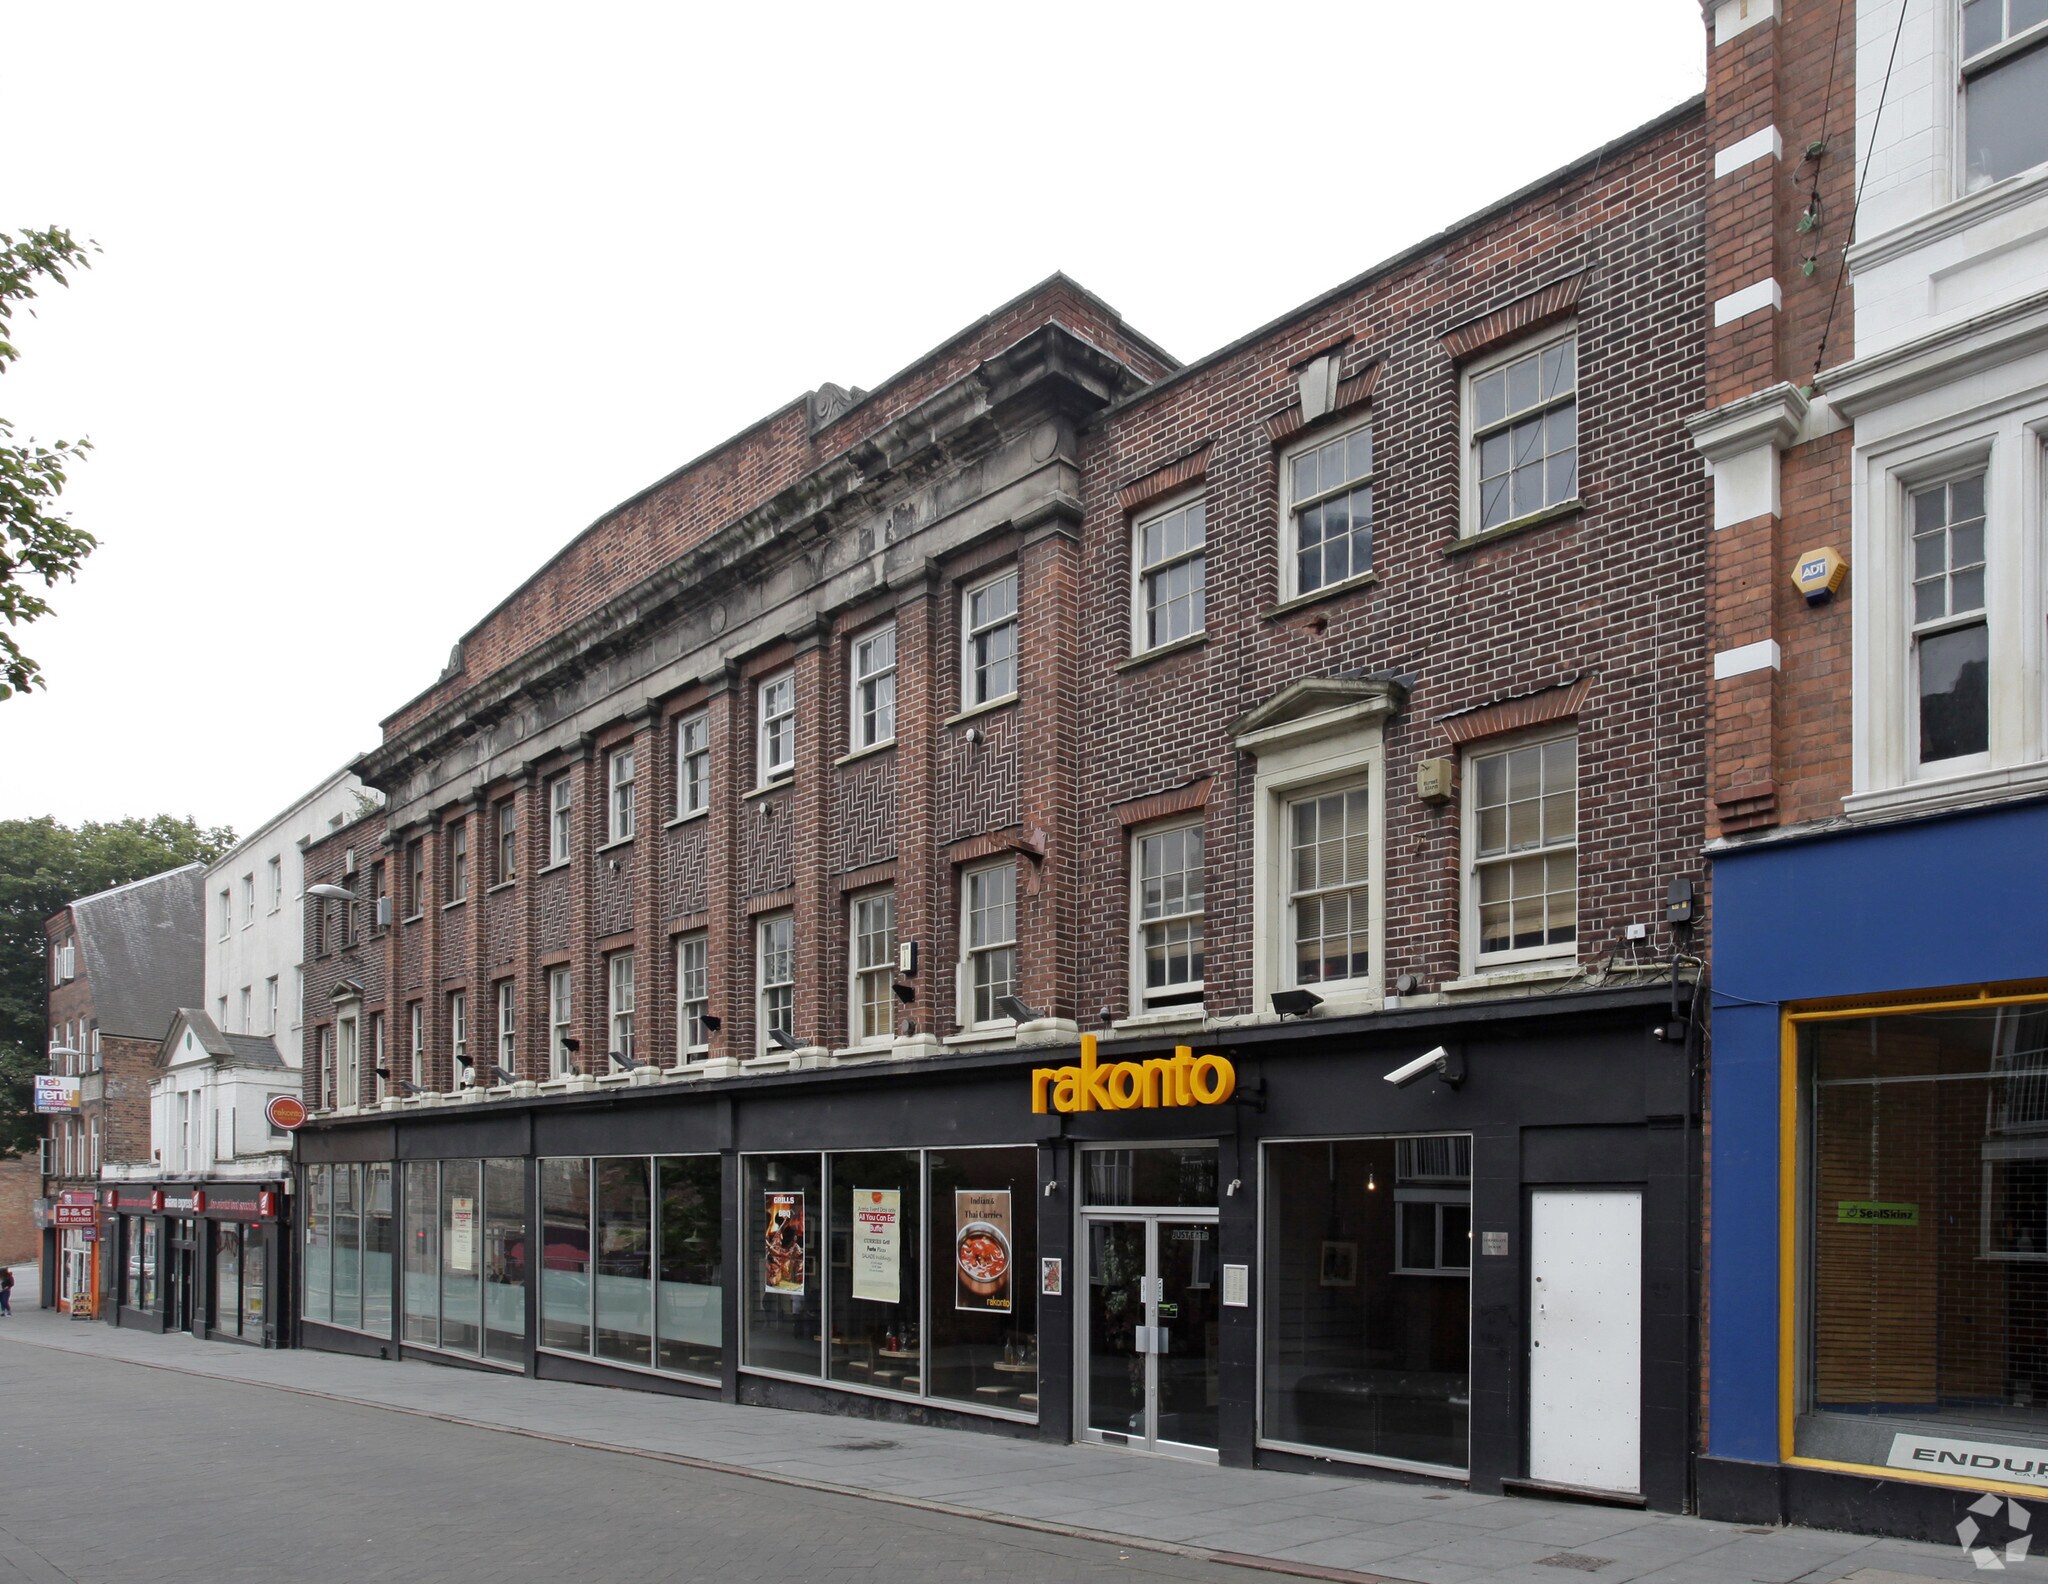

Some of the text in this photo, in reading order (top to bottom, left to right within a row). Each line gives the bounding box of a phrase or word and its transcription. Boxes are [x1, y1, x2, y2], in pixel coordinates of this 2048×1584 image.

[1803, 562, 1826, 578] ADT
[1032, 1034, 1236, 1114] rakonto
[273, 1108, 303, 1117] rakonto
[773, 1196, 795, 1205] GRILLS
[970, 1197, 990, 1205] Indian
[59, 1208, 92, 1217] B&G
[778, 1209, 791, 1219] BBQ
[965, 1210, 1003, 1219] Thai Curries
[866, 1213, 876, 1221] You
[876, 1214, 887, 1222] Can
[1172, 1231, 1190, 1240] JUST
[1190, 1231, 1204, 1240] EAT
[986, 1295, 1010, 1308] rakonto
